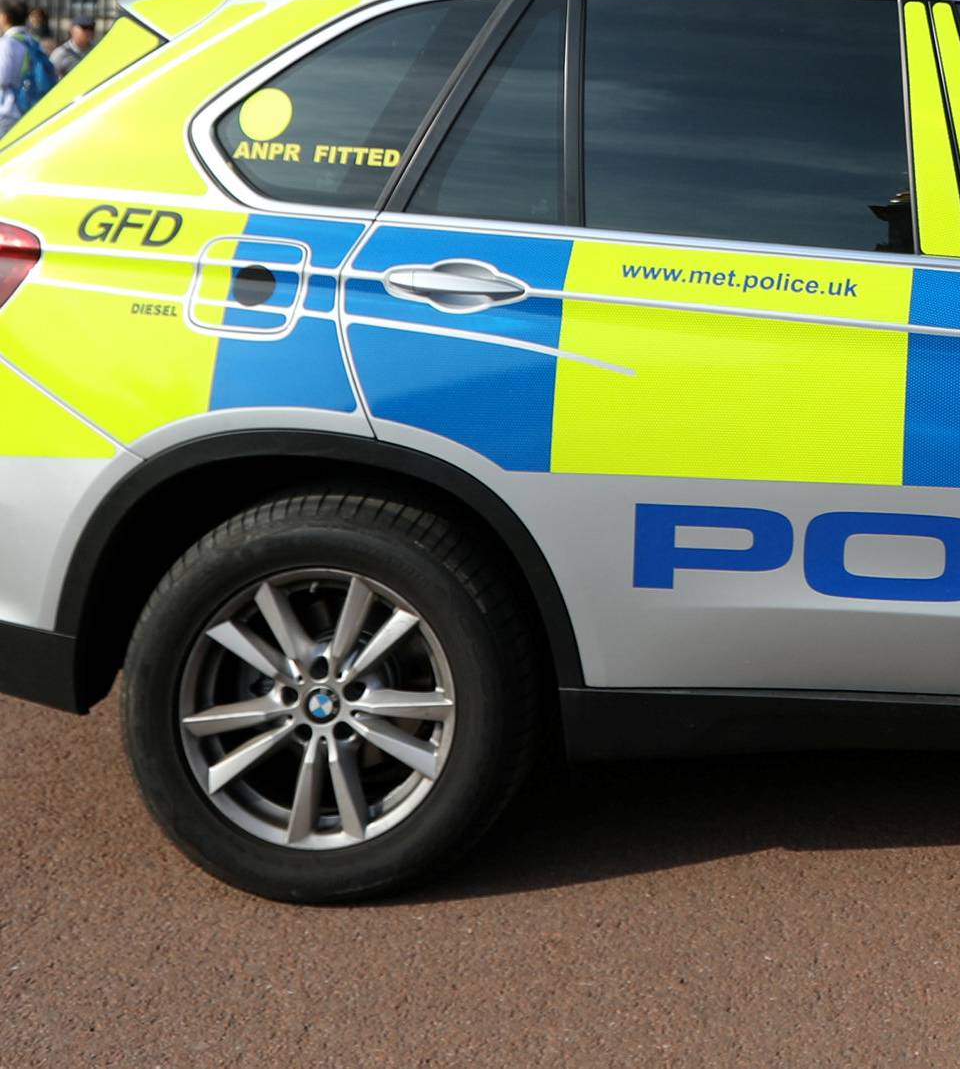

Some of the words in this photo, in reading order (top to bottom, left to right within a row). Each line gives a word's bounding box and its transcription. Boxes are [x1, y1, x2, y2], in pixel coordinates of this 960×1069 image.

[232, 141, 301, 162] ANPR
[313, 145, 401, 167] FITTED
[78, 204, 183, 247] GFD
[622, 264, 858, 297] www.met.police.uk
[130, 303, 178, 317] DIESEL
